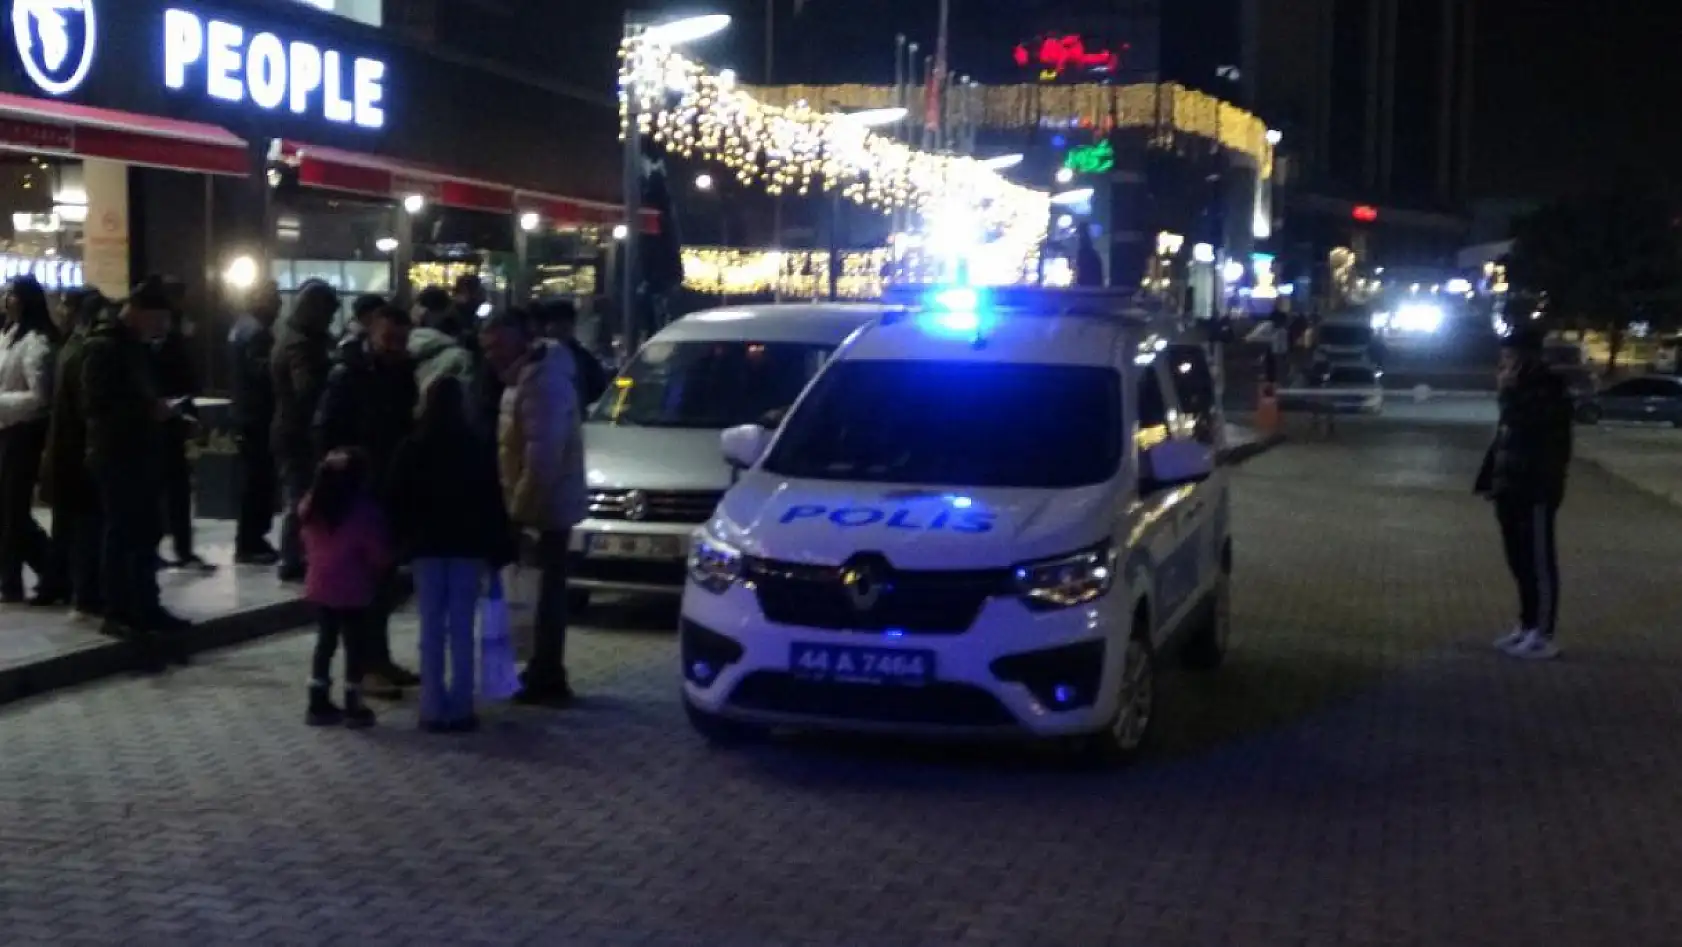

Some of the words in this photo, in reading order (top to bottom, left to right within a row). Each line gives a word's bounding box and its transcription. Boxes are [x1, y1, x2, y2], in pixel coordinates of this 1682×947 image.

[164, 9, 384, 127] PEOPLE
[798, 649, 829, 670] 44
[835, 651, 856, 672] A
